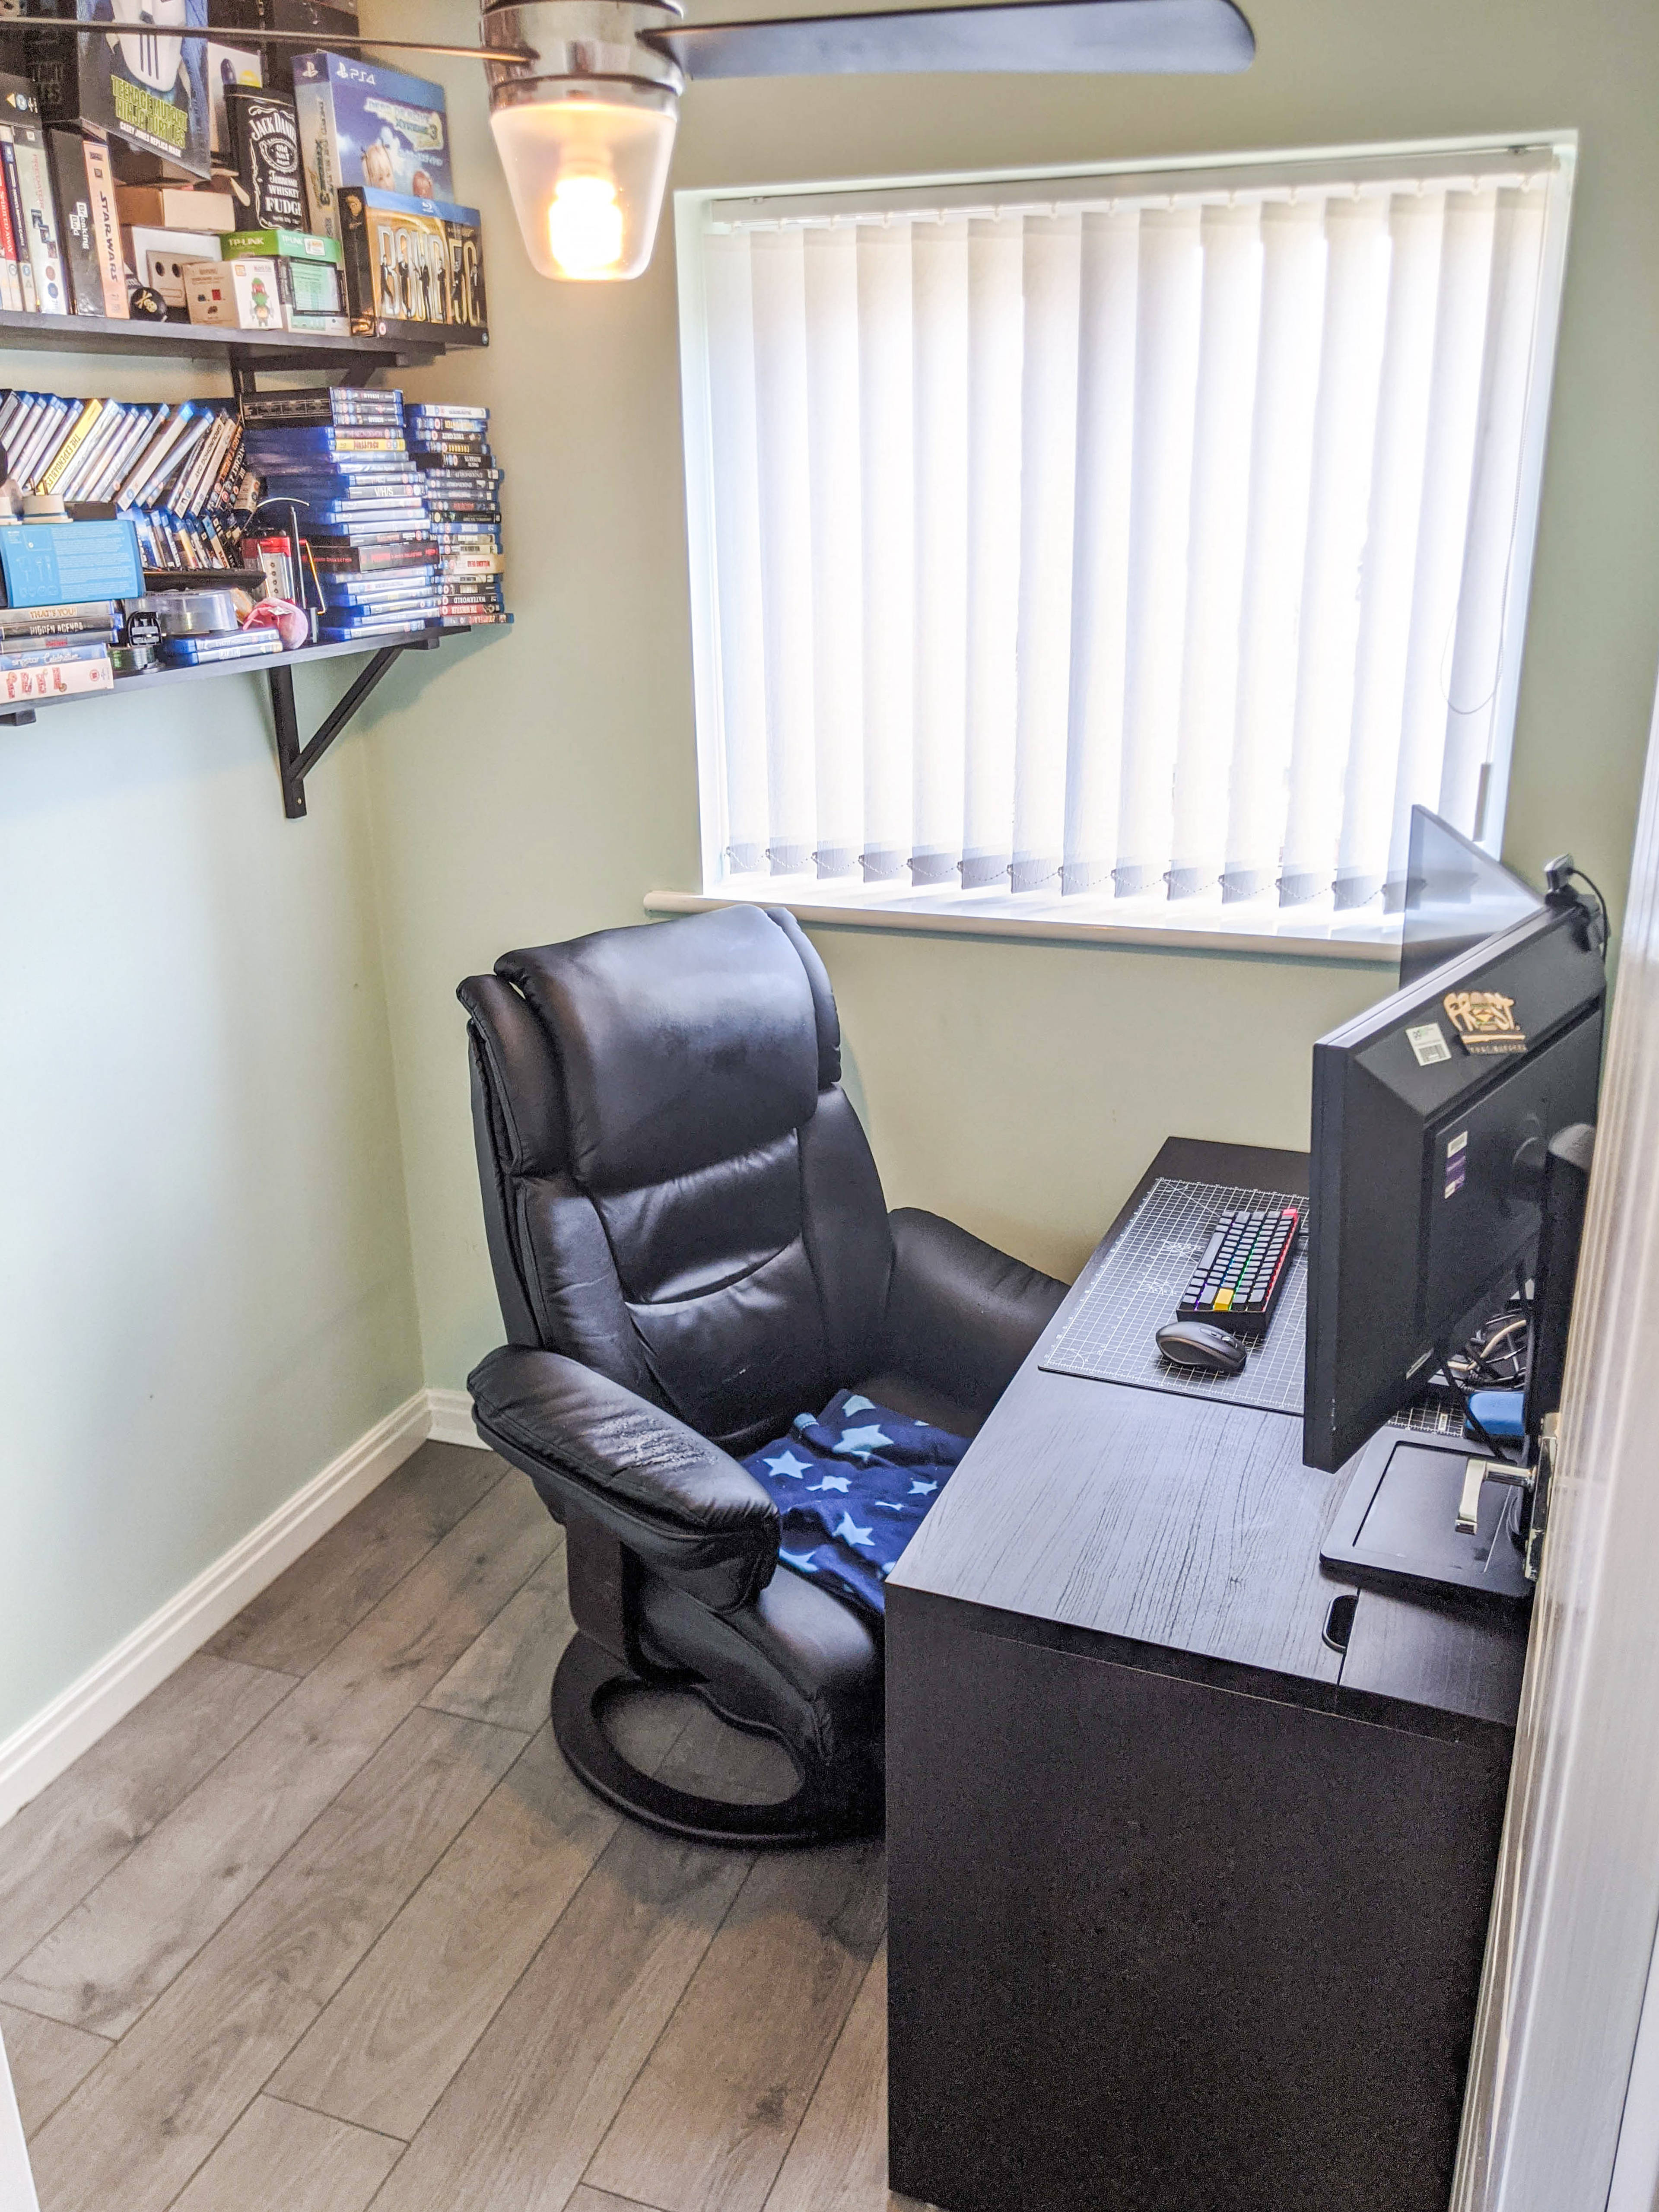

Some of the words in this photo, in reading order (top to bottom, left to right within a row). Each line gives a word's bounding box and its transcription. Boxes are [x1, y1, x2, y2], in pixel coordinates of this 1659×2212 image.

[350, 68, 376, 85] PS4
[120, 121, 135, 134] CASEY
[135, 129, 150, 142] JONES
[248, 116, 275, 141] JACK
[265, 197, 302, 216] FUDGE
[69, 213, 80, 236] Bad
[76, 201, 90, 250] Breaking
[4, 230, 13, 253] AWAY
[99, 191, 113, 237] STAR
[106, 238, 118, 283] WARS
[228, 237, 264, 246] TP-LINK
[69, 434, 81, 448] THE
[202, 424, 222, 465] GROUNDHOG
[45, 445, 73, 488] EXPENDABLES
[195, 464, 203, 479] DAY
[374, 487, 394, 496] V/H/S
[29, 608, 57, 620] THAT'S
[57, 607, 77, 617] YOU!
[30, 624, 55, 636] HIDDEN
[57, 622, 84, 633] AGENDA
